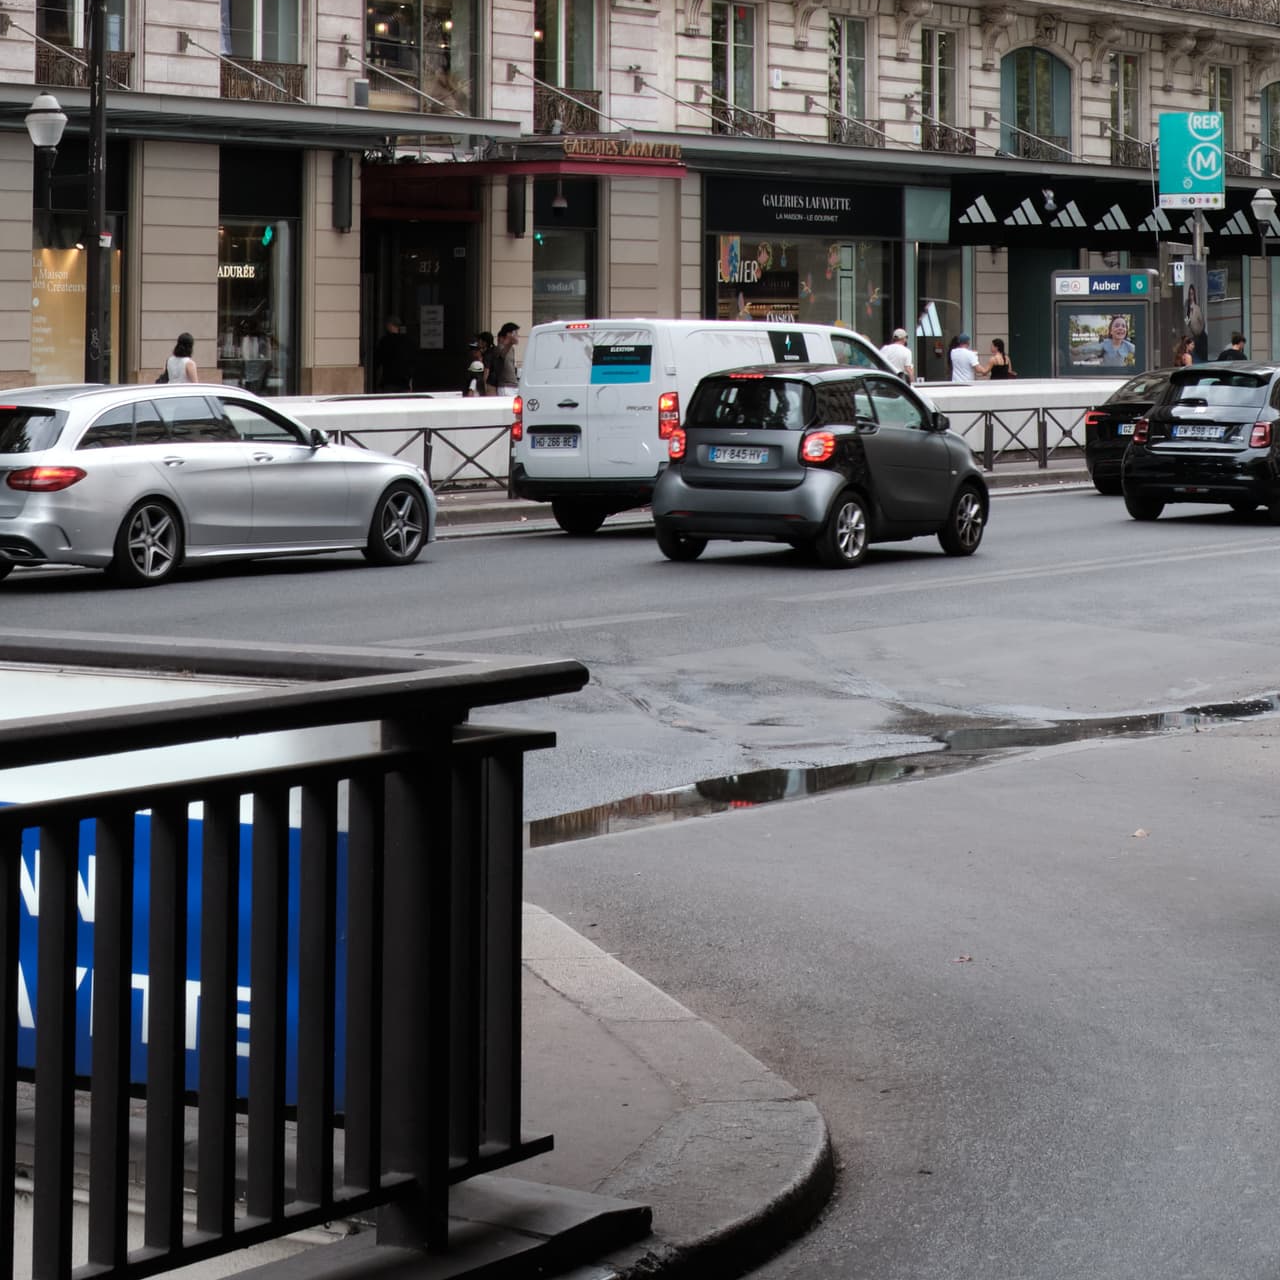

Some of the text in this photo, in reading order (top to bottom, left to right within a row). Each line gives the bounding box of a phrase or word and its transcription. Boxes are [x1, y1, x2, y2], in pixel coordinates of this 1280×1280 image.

[1193, 115, 1220, 130] RER
[563, 138, 682, 159] GALERIES LAFAYETTE
[1196, 151, 1216, 172] M
[762, 193, 852, 211] GALERIES LAFAYETTE
[40, 269, 69, 280] Maison
[217, 264, 256, 278] ADURÉE
[1092, 280, 1121, 292] Auber
